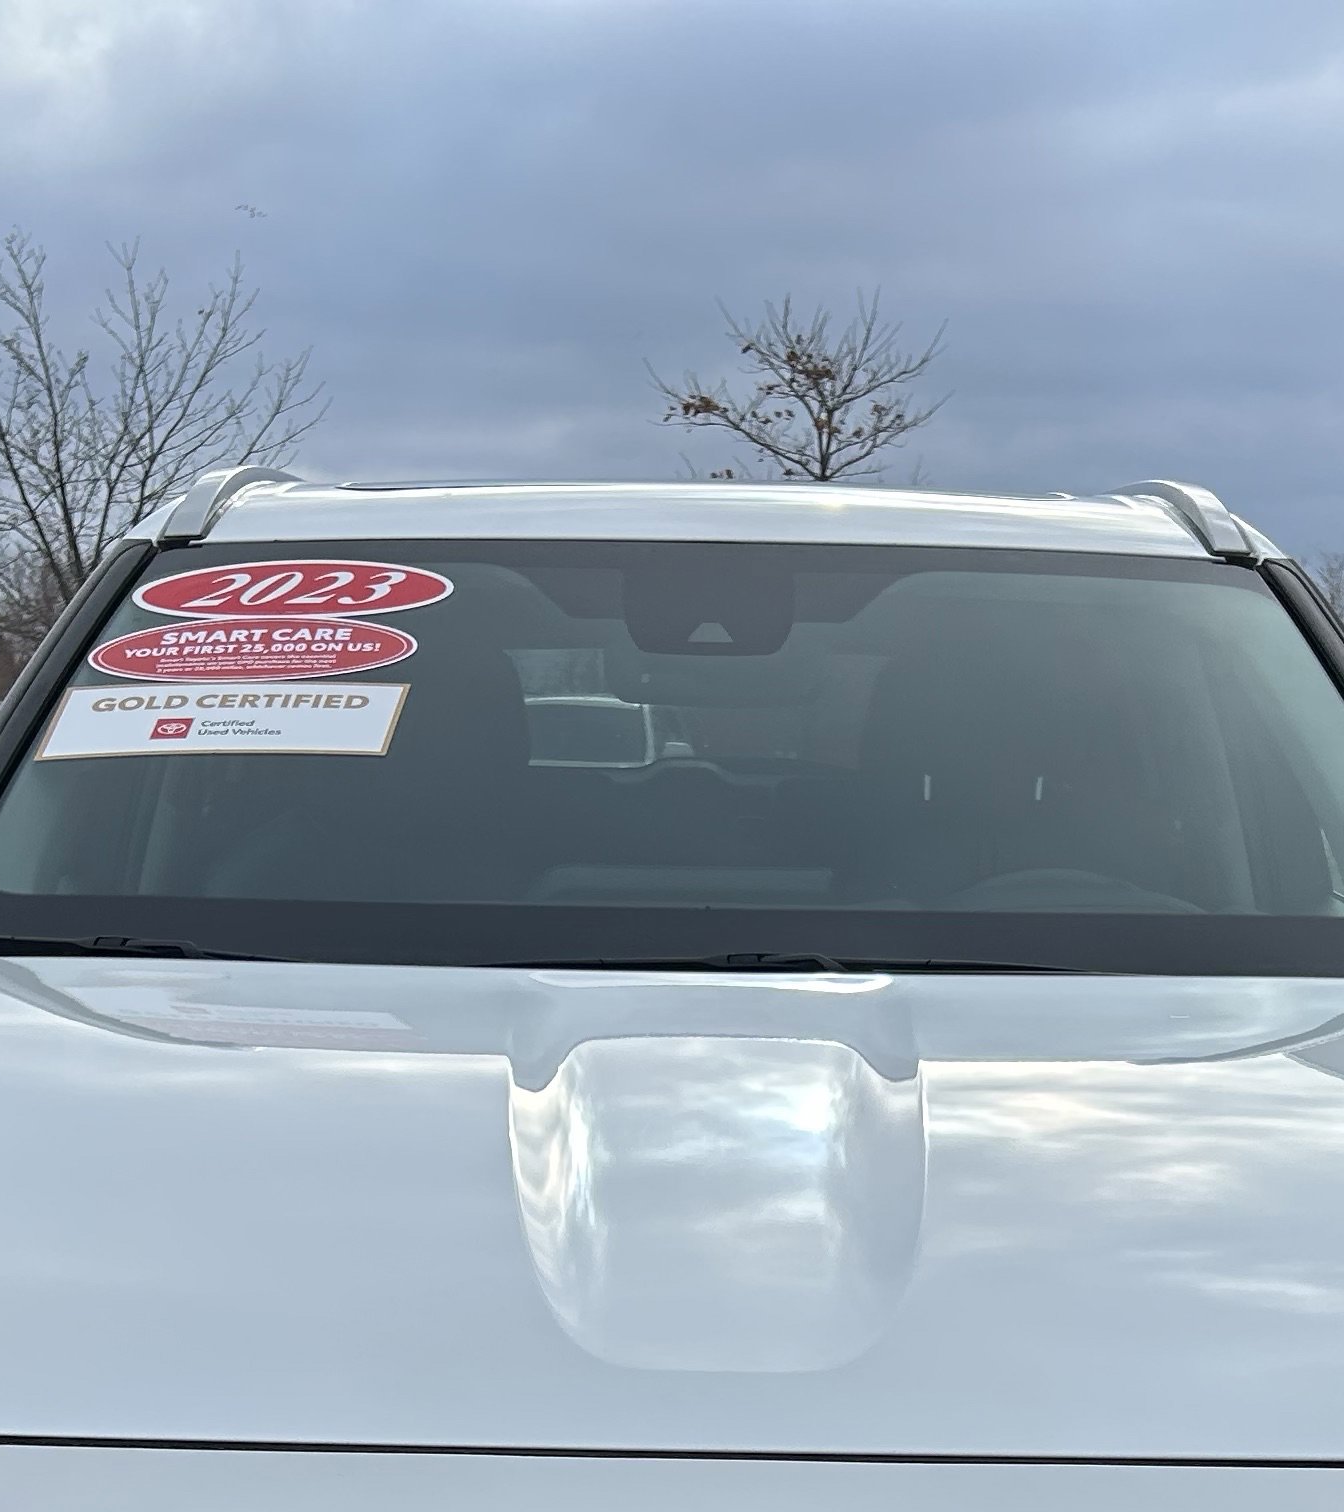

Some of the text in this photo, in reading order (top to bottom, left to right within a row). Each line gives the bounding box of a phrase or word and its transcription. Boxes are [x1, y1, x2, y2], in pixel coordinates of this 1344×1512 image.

[179, 571, 407, 608] 2023
[160, 628, 354, 645] SMART CARE
[124, 642, 382, 659] YOUR FIRST 25,000 ON US!
[91, 694, 370, 712] GOLD CERTIFIED
[197, 728, 282, 736] Used Vehicles
